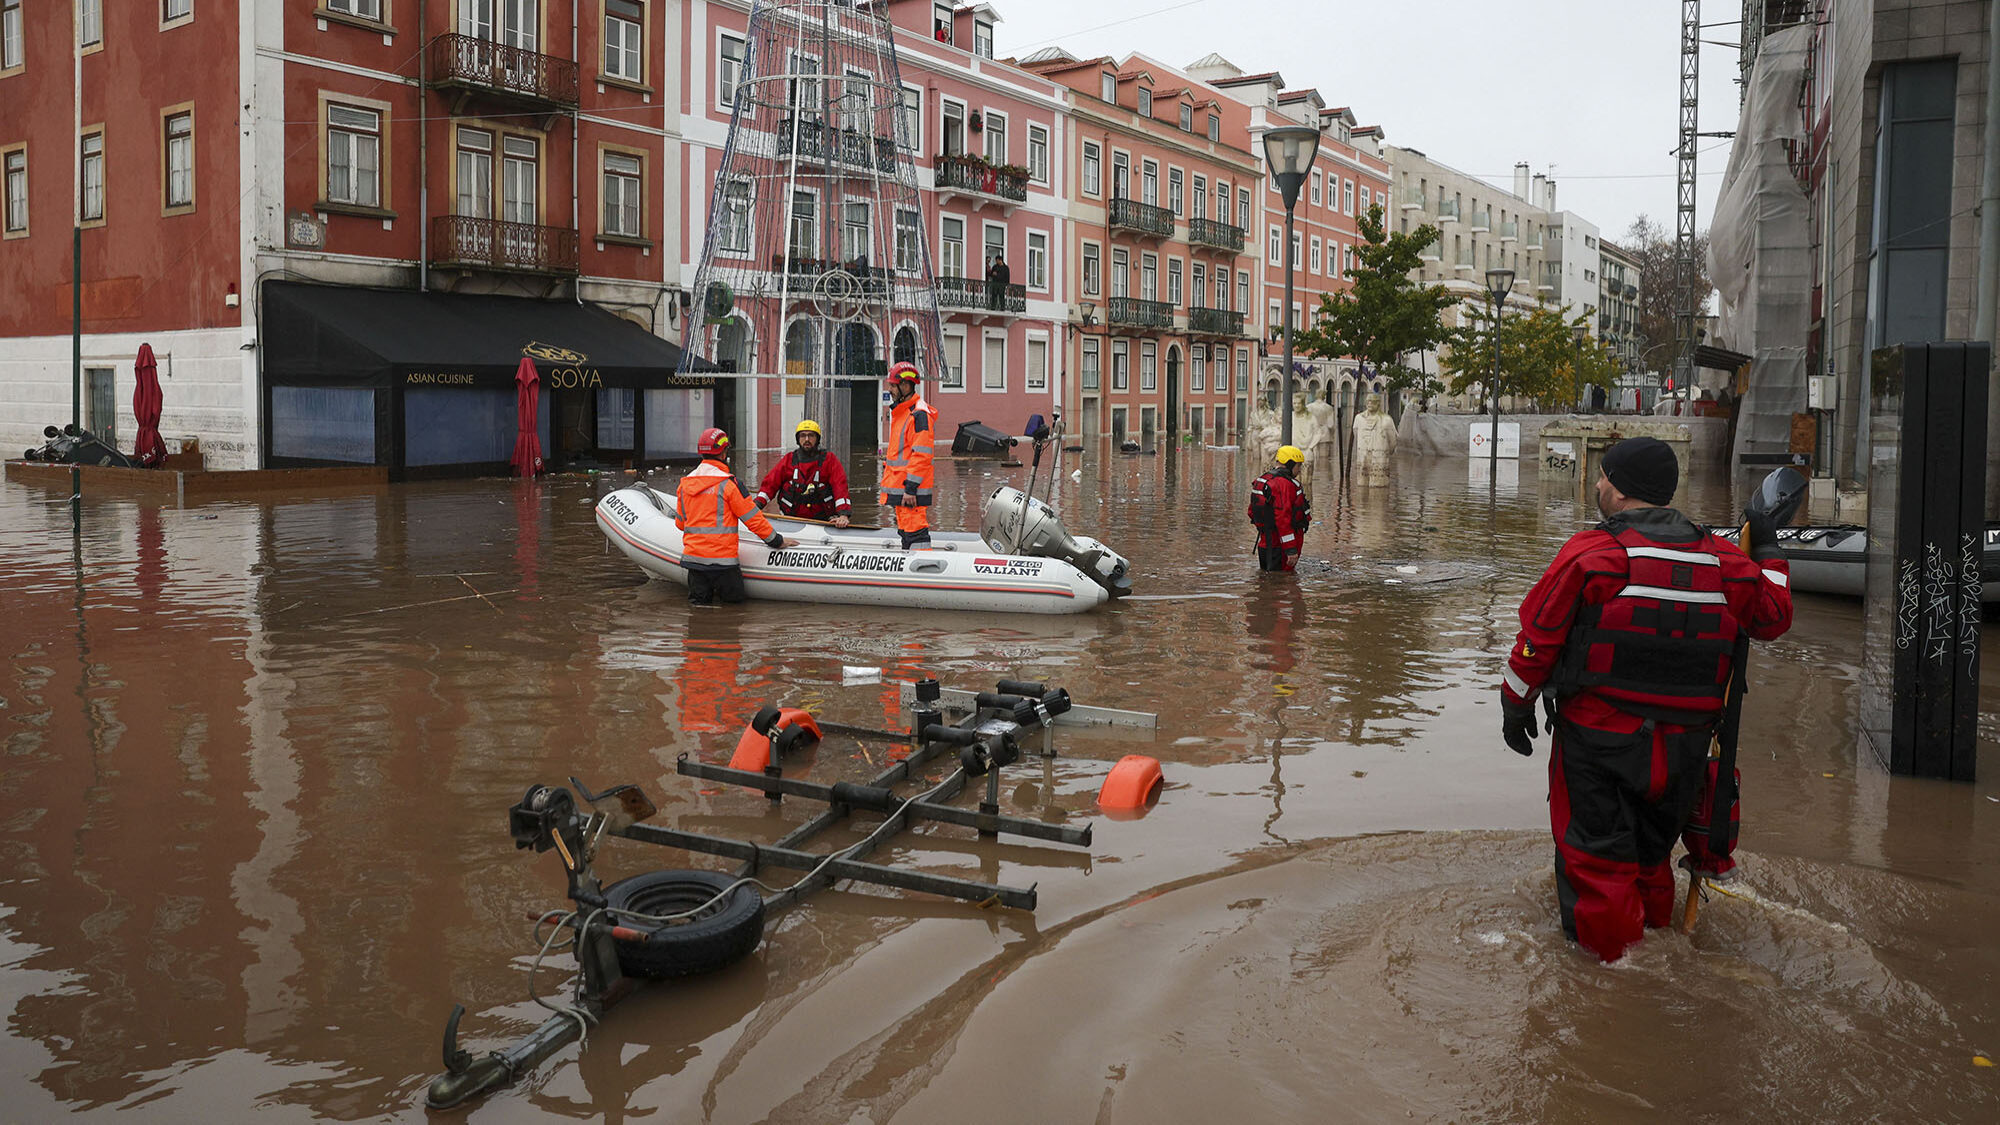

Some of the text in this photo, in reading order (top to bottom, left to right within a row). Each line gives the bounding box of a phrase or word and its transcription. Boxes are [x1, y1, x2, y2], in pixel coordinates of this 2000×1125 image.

[407, 373, 474, 384] ASIAN CUISINE
[551, 369, 602, 388] SOYA
[667, 376, 716, 385] NOODLE BAR
[605, 495, 639, 525] D8767CS
[767, 551, 905, 572] BOMBEIROS ALCABIDECHE
[974, 565, 1041, 576] VALIANT
